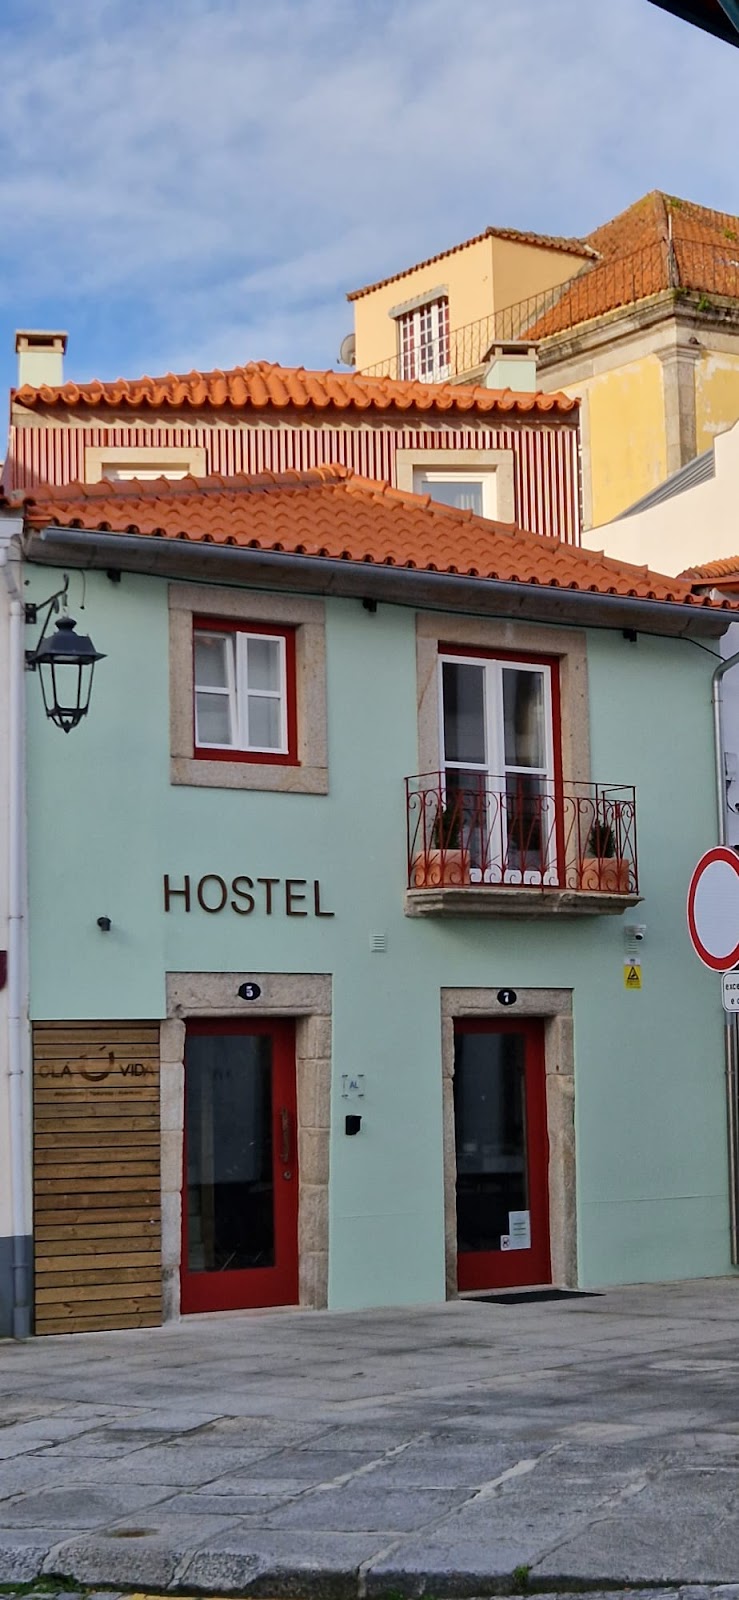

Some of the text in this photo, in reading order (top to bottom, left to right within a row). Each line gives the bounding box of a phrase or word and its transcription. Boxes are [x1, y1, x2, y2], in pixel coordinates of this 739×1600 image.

[163, 874, 335, 916] HOSTEL
[246, 985, 254, 997] 5
[503, 992, 510, 1003] 7
[120, 1063, 156, 1078] VIDA
[349, 1080, 359, 1089] AL
